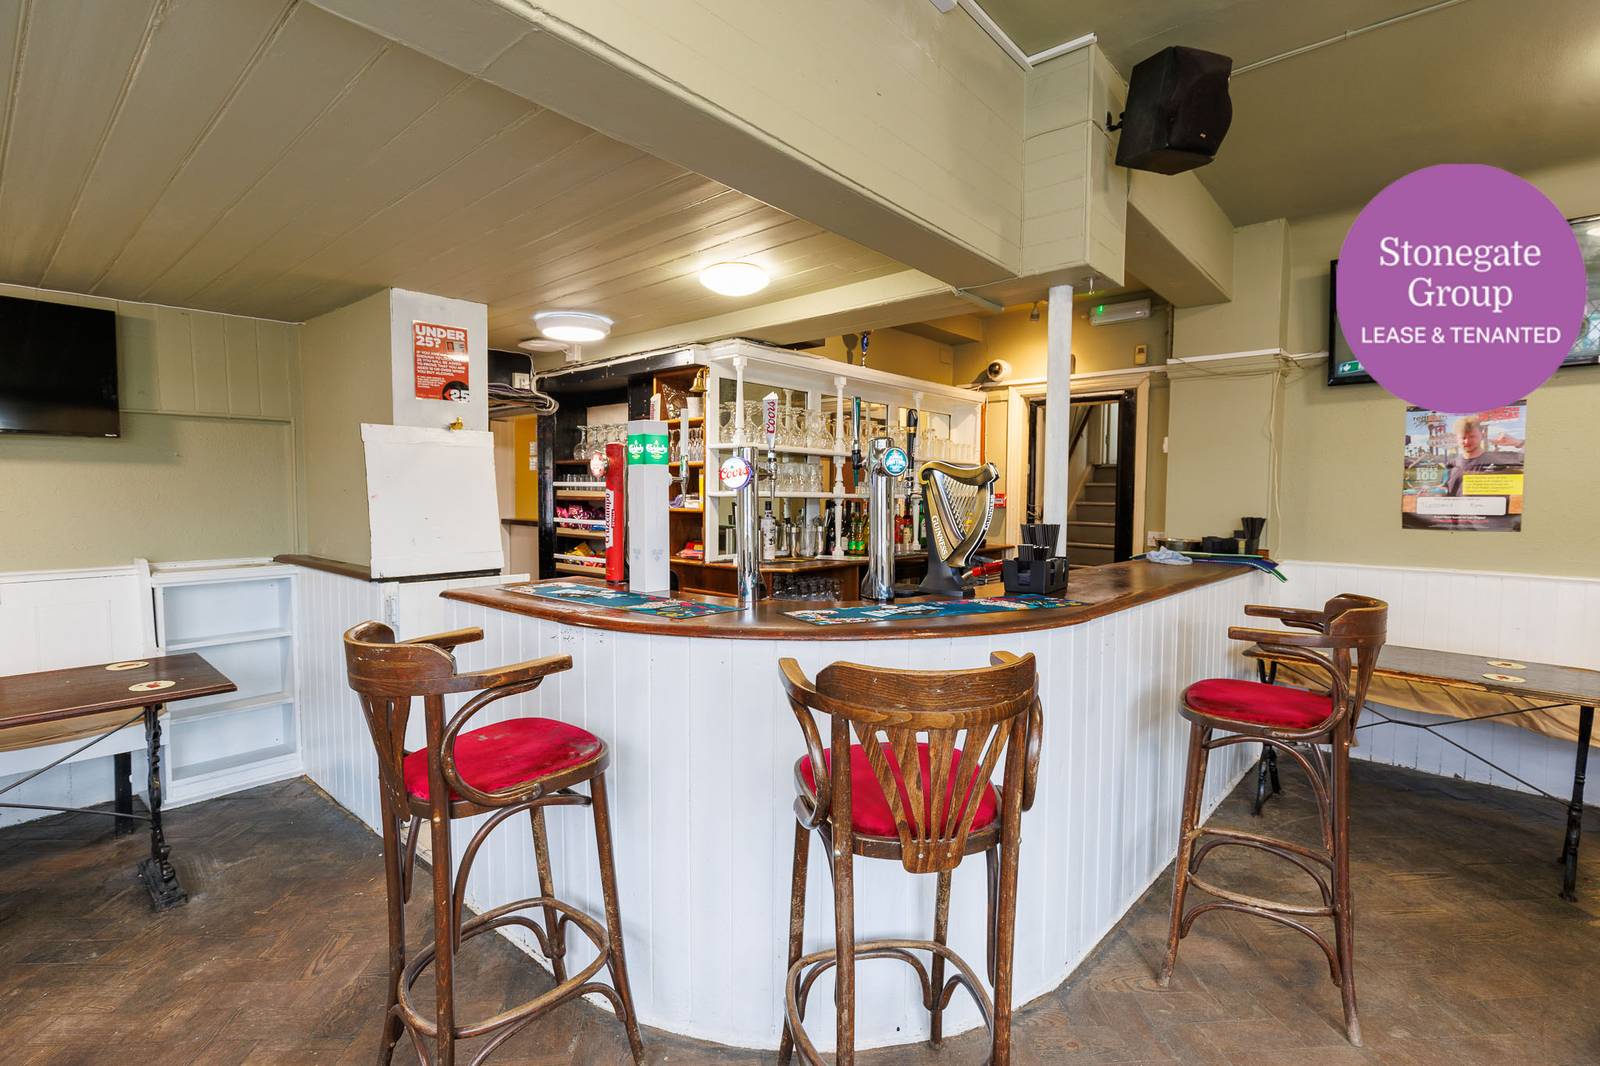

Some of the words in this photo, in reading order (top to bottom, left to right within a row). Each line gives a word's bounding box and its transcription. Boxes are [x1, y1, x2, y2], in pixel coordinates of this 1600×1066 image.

[415, 324, 465, 341] UNDER
[416, 335, 441, 348] 25?
[767, 400, 776, 434] Coors
[719, 466, 749, 480] Coors
[931, 515, 949, 555] GUINNESS
